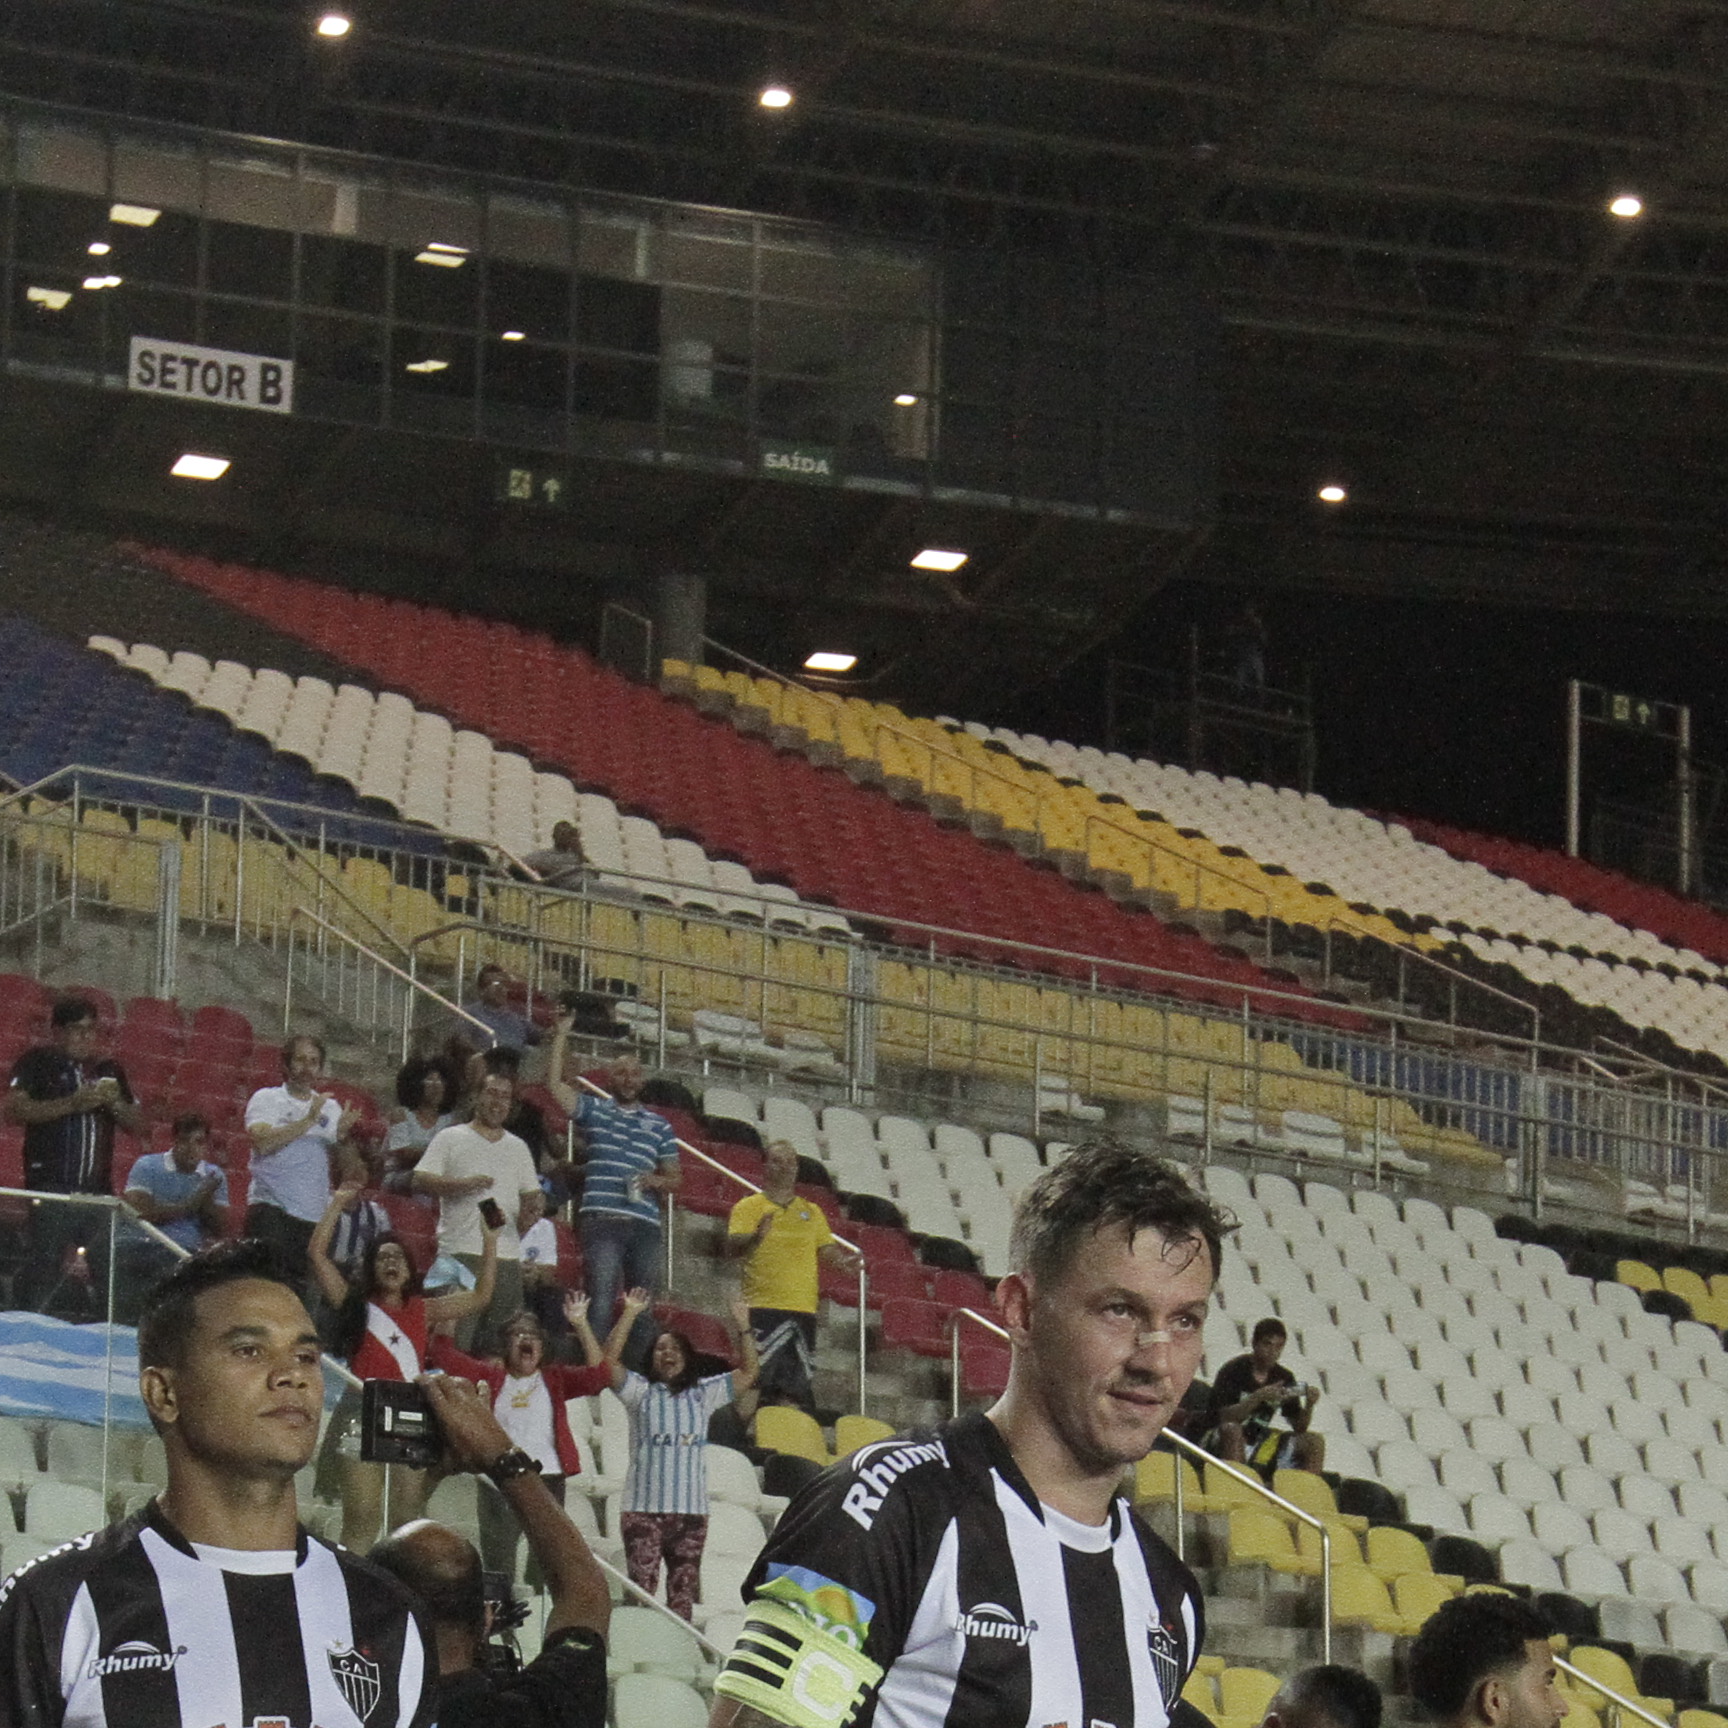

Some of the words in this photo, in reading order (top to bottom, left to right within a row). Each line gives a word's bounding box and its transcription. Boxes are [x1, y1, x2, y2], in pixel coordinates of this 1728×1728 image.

[136, 349, 246, 401] SETOR
[258, 362, 283, 406] B
[763, 451, 830, 475] SAÍDA
[841, 1440, 951, 1531] Rhumy
[955, 1612, 1033, 1646] Rhumy
[87, 1652, 178, 1679] Rhumy
[339, 1659, 370, 1677] CAI
[792, 1651, 854, 1720] C
